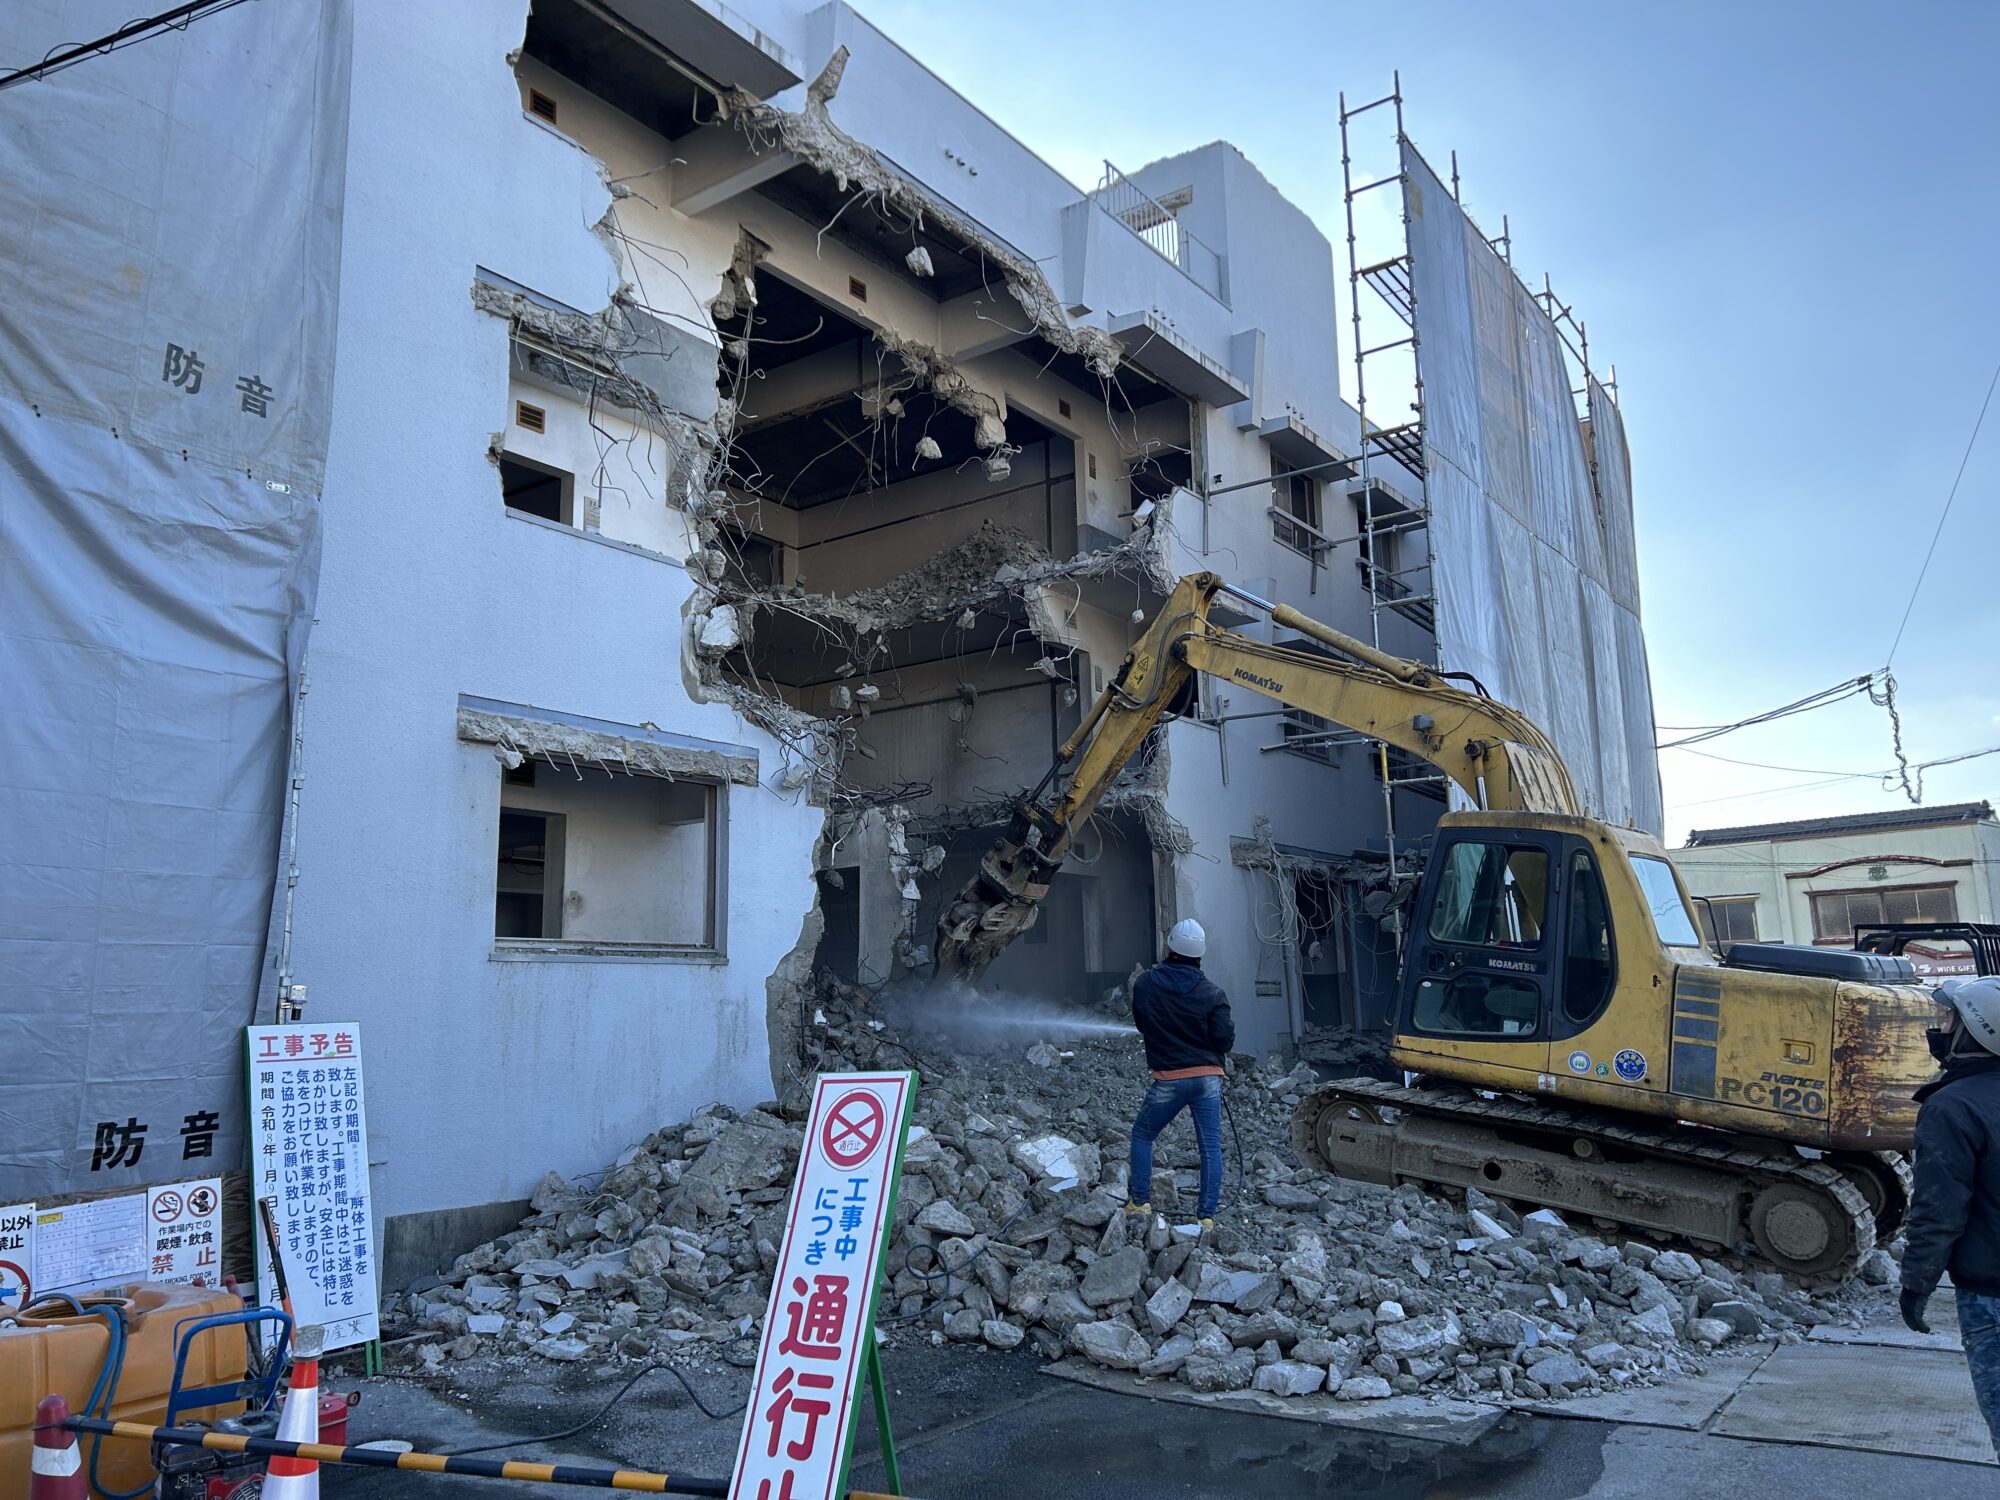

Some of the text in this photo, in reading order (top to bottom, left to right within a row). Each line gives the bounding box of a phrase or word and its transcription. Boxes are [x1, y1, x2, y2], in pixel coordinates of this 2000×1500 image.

[162, 342, 275, 418] 防音
[1234, 668, 1283, 693] KOMATSU
[1489, 959, 1537, 972] KOMATSU
[259, 1032, 353, 1057] 工事予告
[1721, 1077, 1824, 1114] PC120
[1760, 1072, 1825, 1089] avance
[91, 1110, 220, 1171] 防音
[839, 1140, 861, 1151] 通行止
[281, 1071, 302, 1259] ご協力をお願い致します。
[297, 1069, 320, 1287] 気をつけて作業致しますので、
[313, 1069, 338, 1306] おかけ致しますが、安全には特に
[328, 1068, 354, 1305] 致します。工事期間中はご迷惑を
[1, 1214, 32, 1232] 以外
[159, 1220, 211, 1236] 作業場内での
[805, 1188, 838, 1266] につき
[835, 1178, 869, 1261] 工事中
[156, 1231, 213, 1251] 喫煙・飲食
